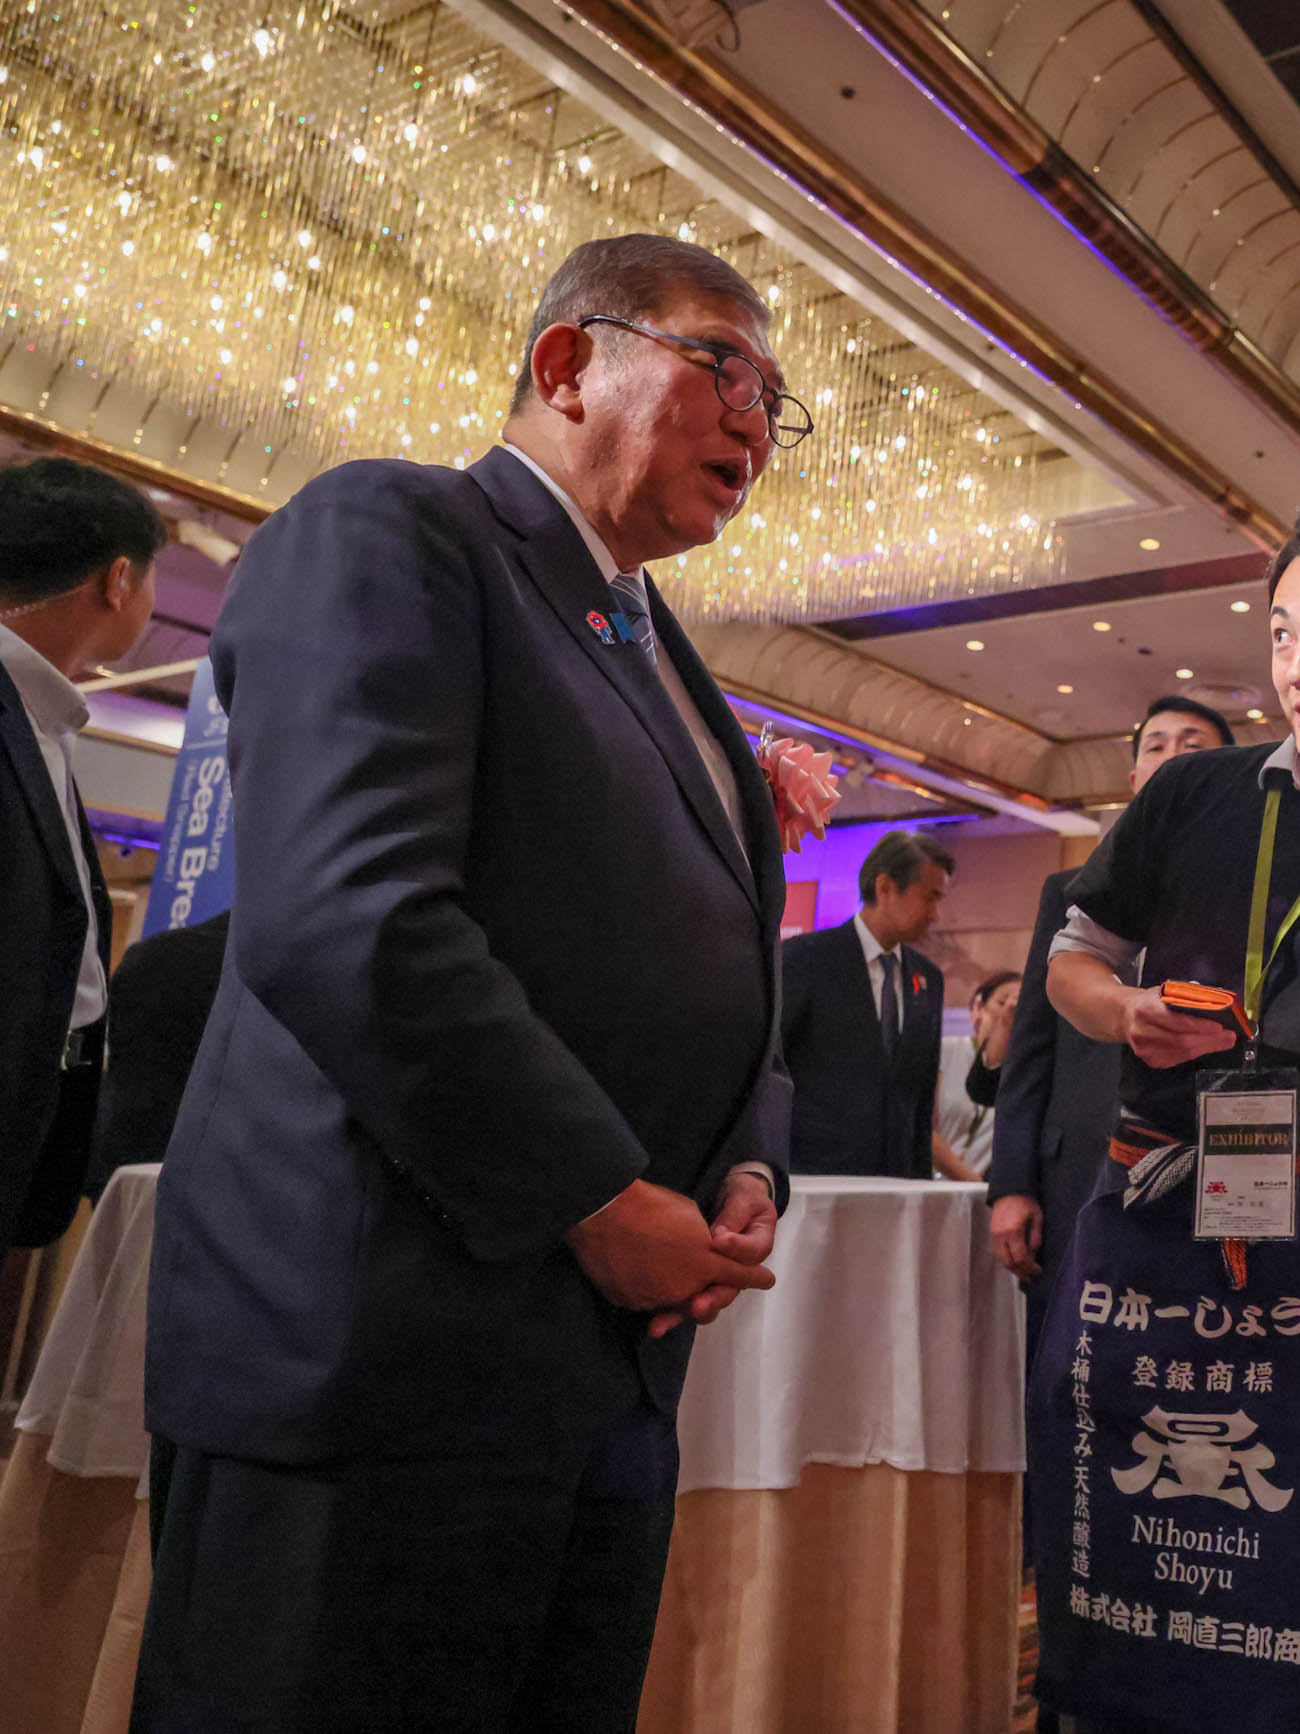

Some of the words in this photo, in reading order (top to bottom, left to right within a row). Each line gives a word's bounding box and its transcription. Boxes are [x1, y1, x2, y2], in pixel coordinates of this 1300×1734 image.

[187, 756, 226, 837] Sea
[168, 847, 209, 929] Bre
[1208, 1132, 1289, 1146] EXHIBITOR
[1131, 1355, 1273, 1393] 登録商標
[1131, 1514, 1260, 1560] Nihonichi
[1154, 1551, 1233, 1595] Shoyu
[1070, 1583, 1158, 1638] 株式会社
